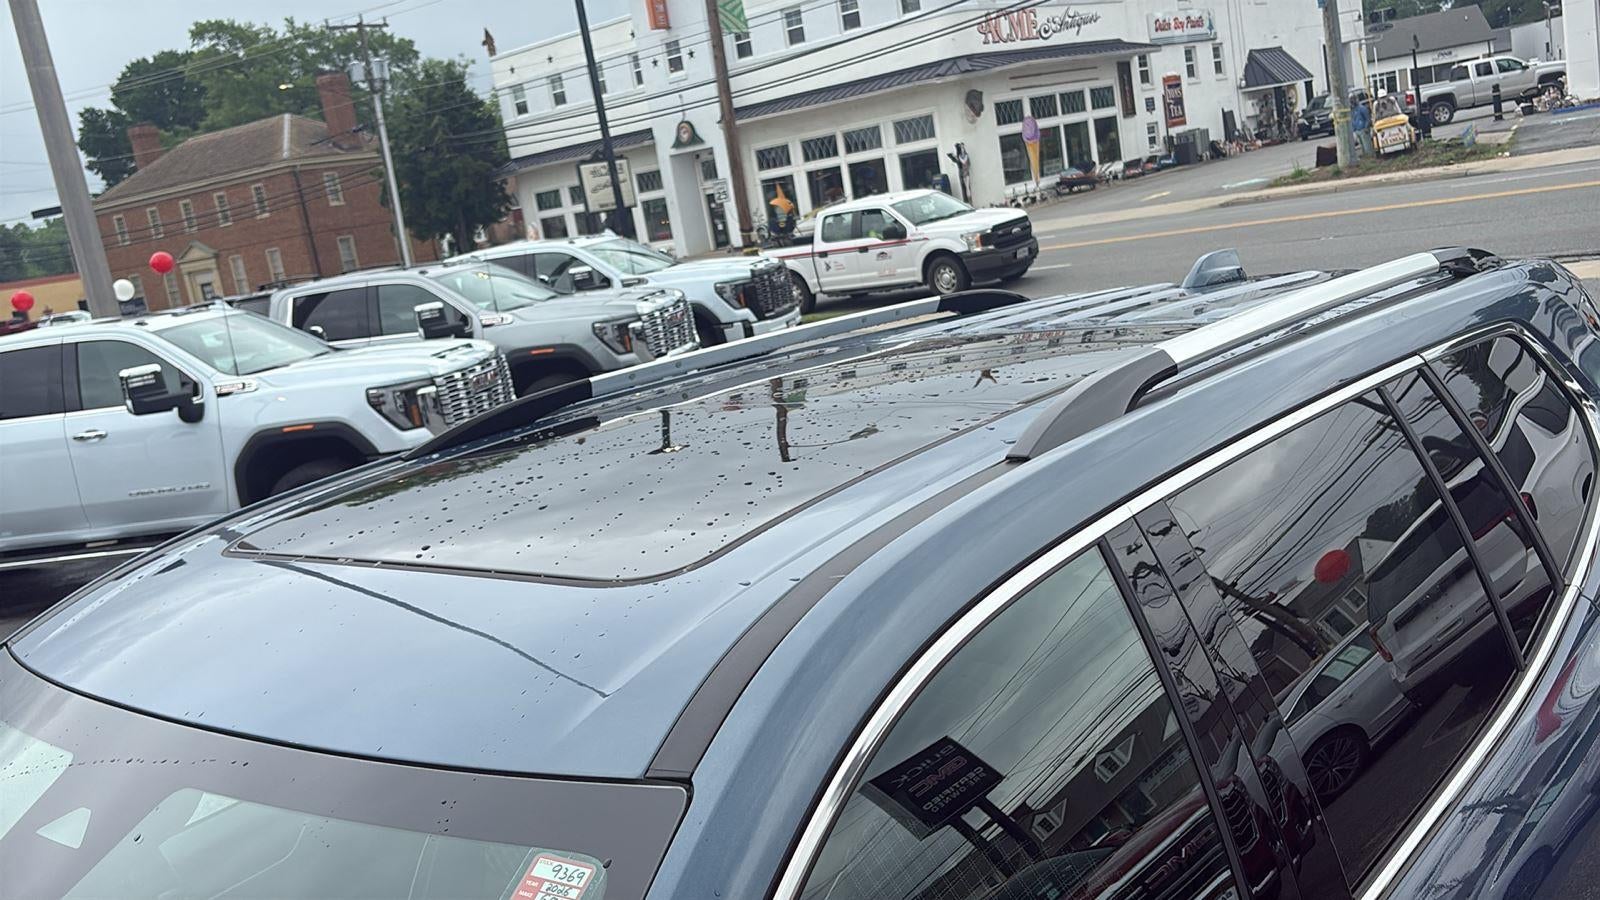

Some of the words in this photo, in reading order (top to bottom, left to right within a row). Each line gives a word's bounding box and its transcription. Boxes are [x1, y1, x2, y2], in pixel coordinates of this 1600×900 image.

[977, 8, 1040, 44] ACME
[1056, 6, 1101, 36] Antiques
[1155, 18, 1171, 33] Dutch
[1173, 16, 1185, 33] Boy
[1186, 15, 1205, 29] Paints
[1169, 104, 1183, 118] TEA
[716, 190, 729, 201] 25
[552, 864, 586, 885] 9369
[546, 884, 570, 897] 2026
